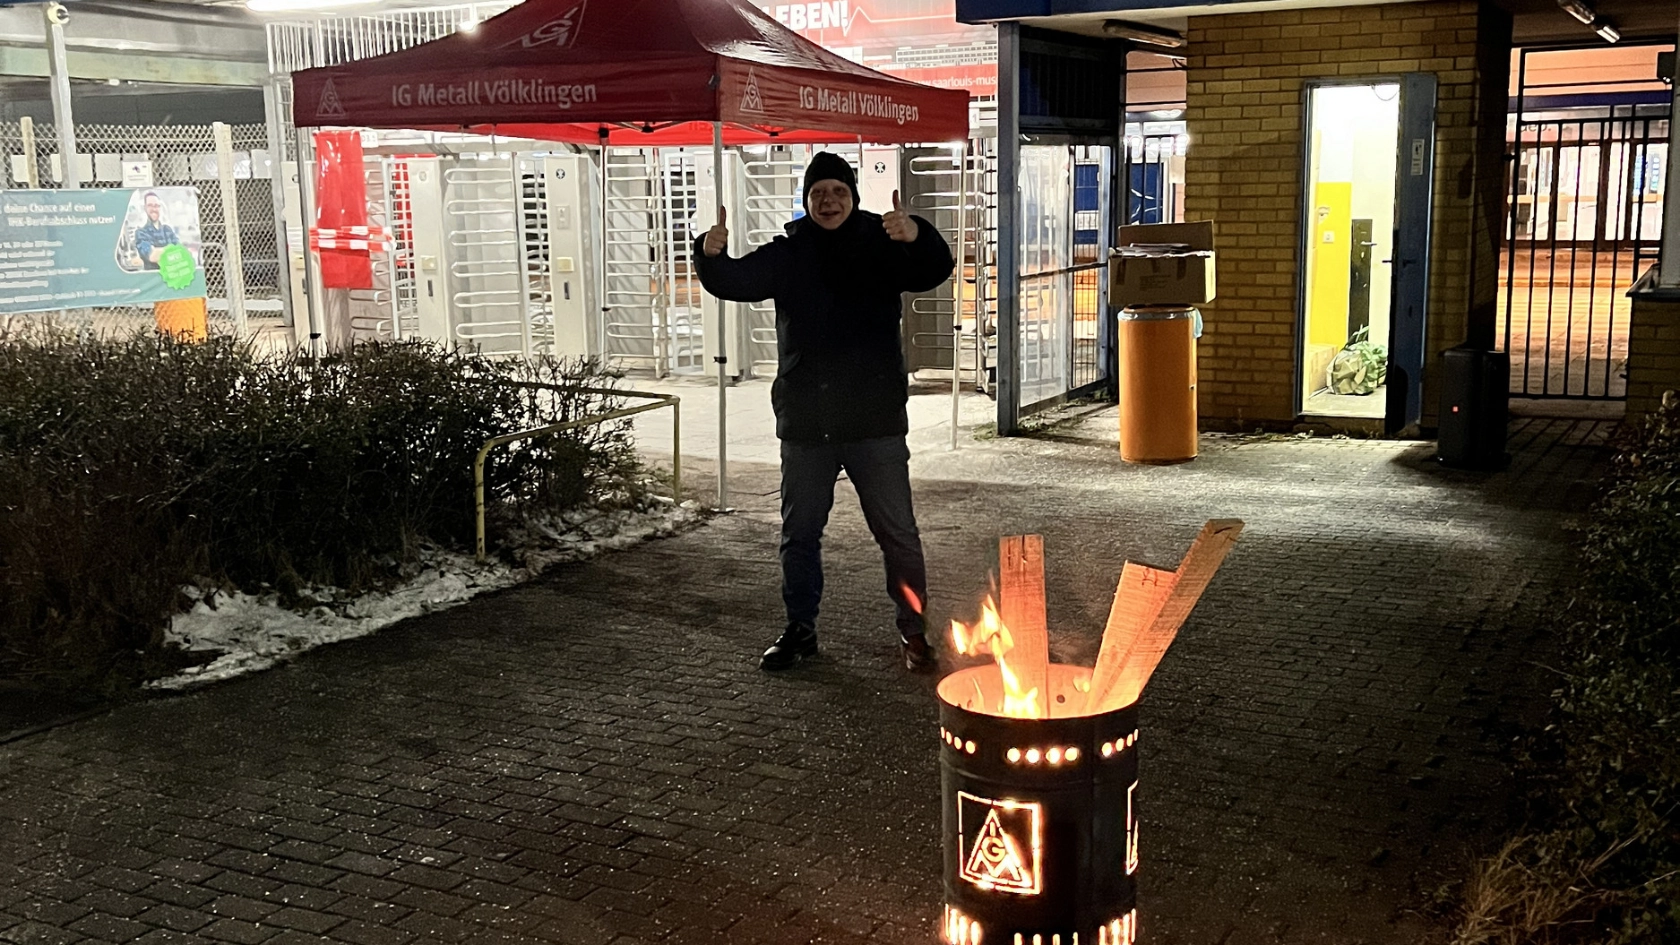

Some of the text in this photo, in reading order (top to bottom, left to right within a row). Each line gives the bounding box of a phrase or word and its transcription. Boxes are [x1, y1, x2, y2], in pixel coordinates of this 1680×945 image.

[763, 1, 848, 30] EBEN!
[392, 79, 597, 109] IG Metall Völklingen
[800, 86, 919, 125] IG Metall Völklingen
[29, 203, 57, 213] Chance
[59, 202, 72, 213] auf
[74, 204, 95, 212] einen
[89, 215, 115, 224] nutzen!
